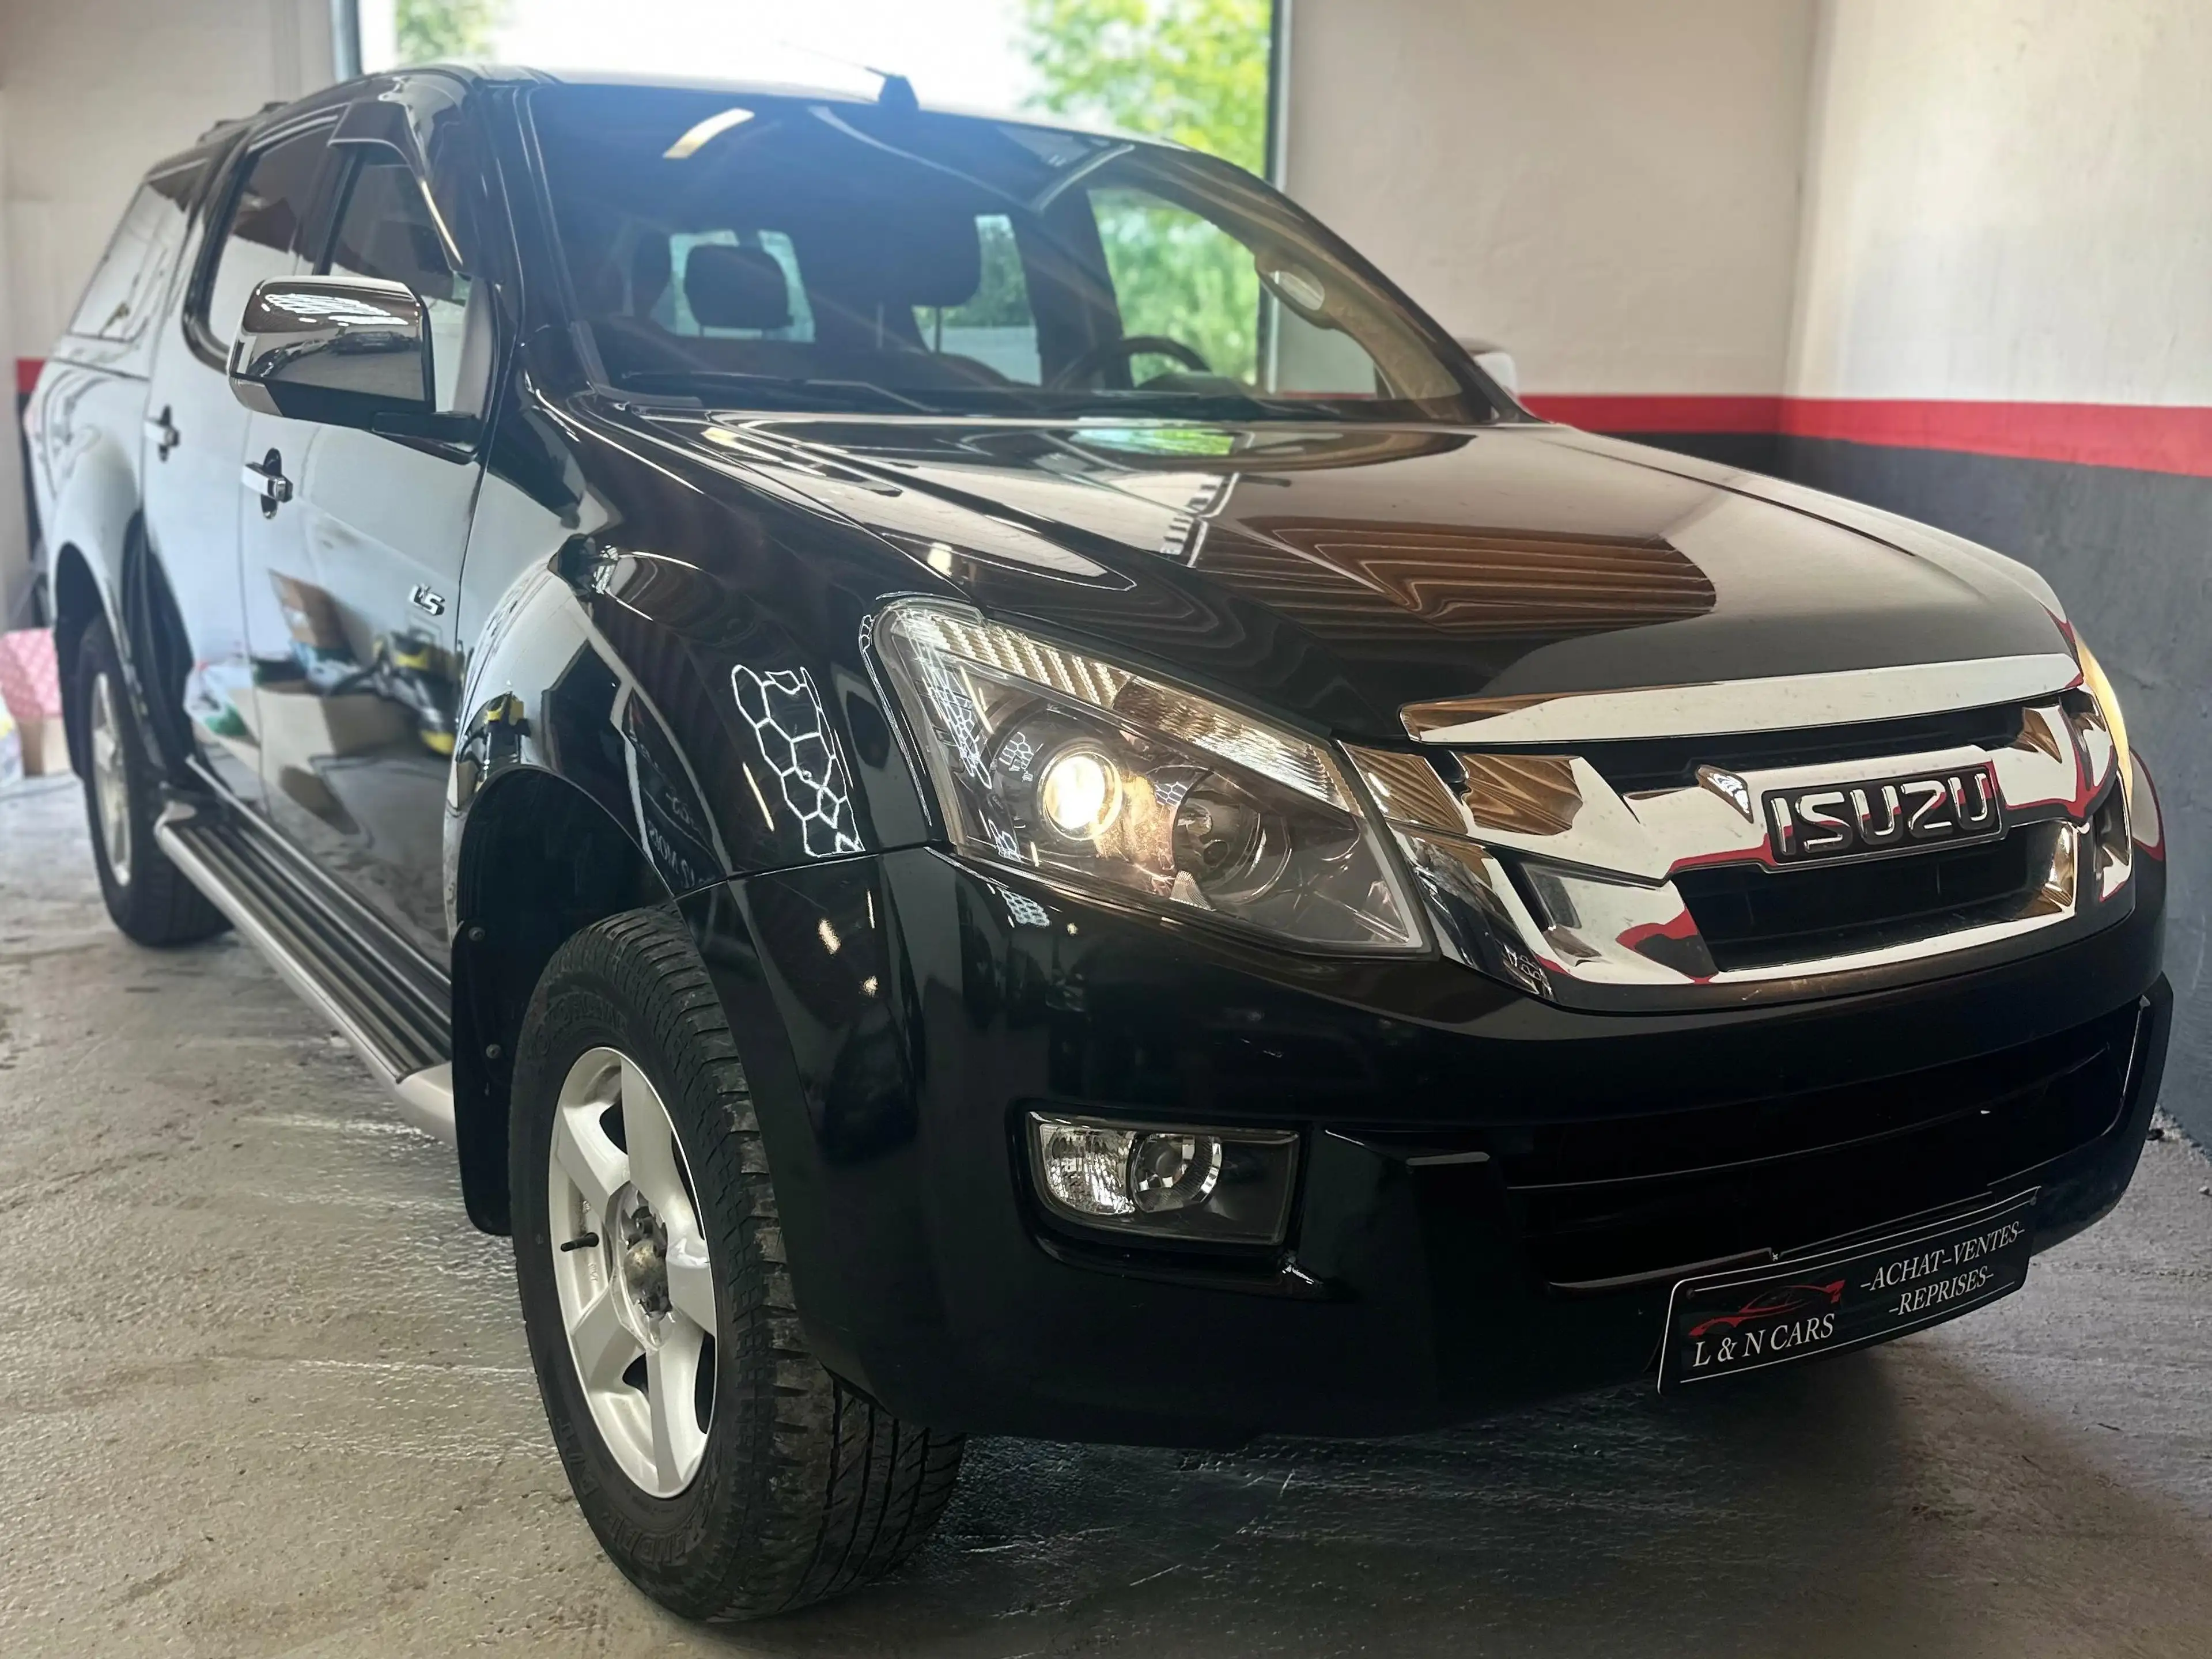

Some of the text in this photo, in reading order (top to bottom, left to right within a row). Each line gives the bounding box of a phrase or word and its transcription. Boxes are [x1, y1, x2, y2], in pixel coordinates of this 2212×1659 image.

[408, 584, 445, 616] LS
[1770, 772, 1993, 856] ISUZU
[1692, 1313, 1835, 1367] L & N CARS
